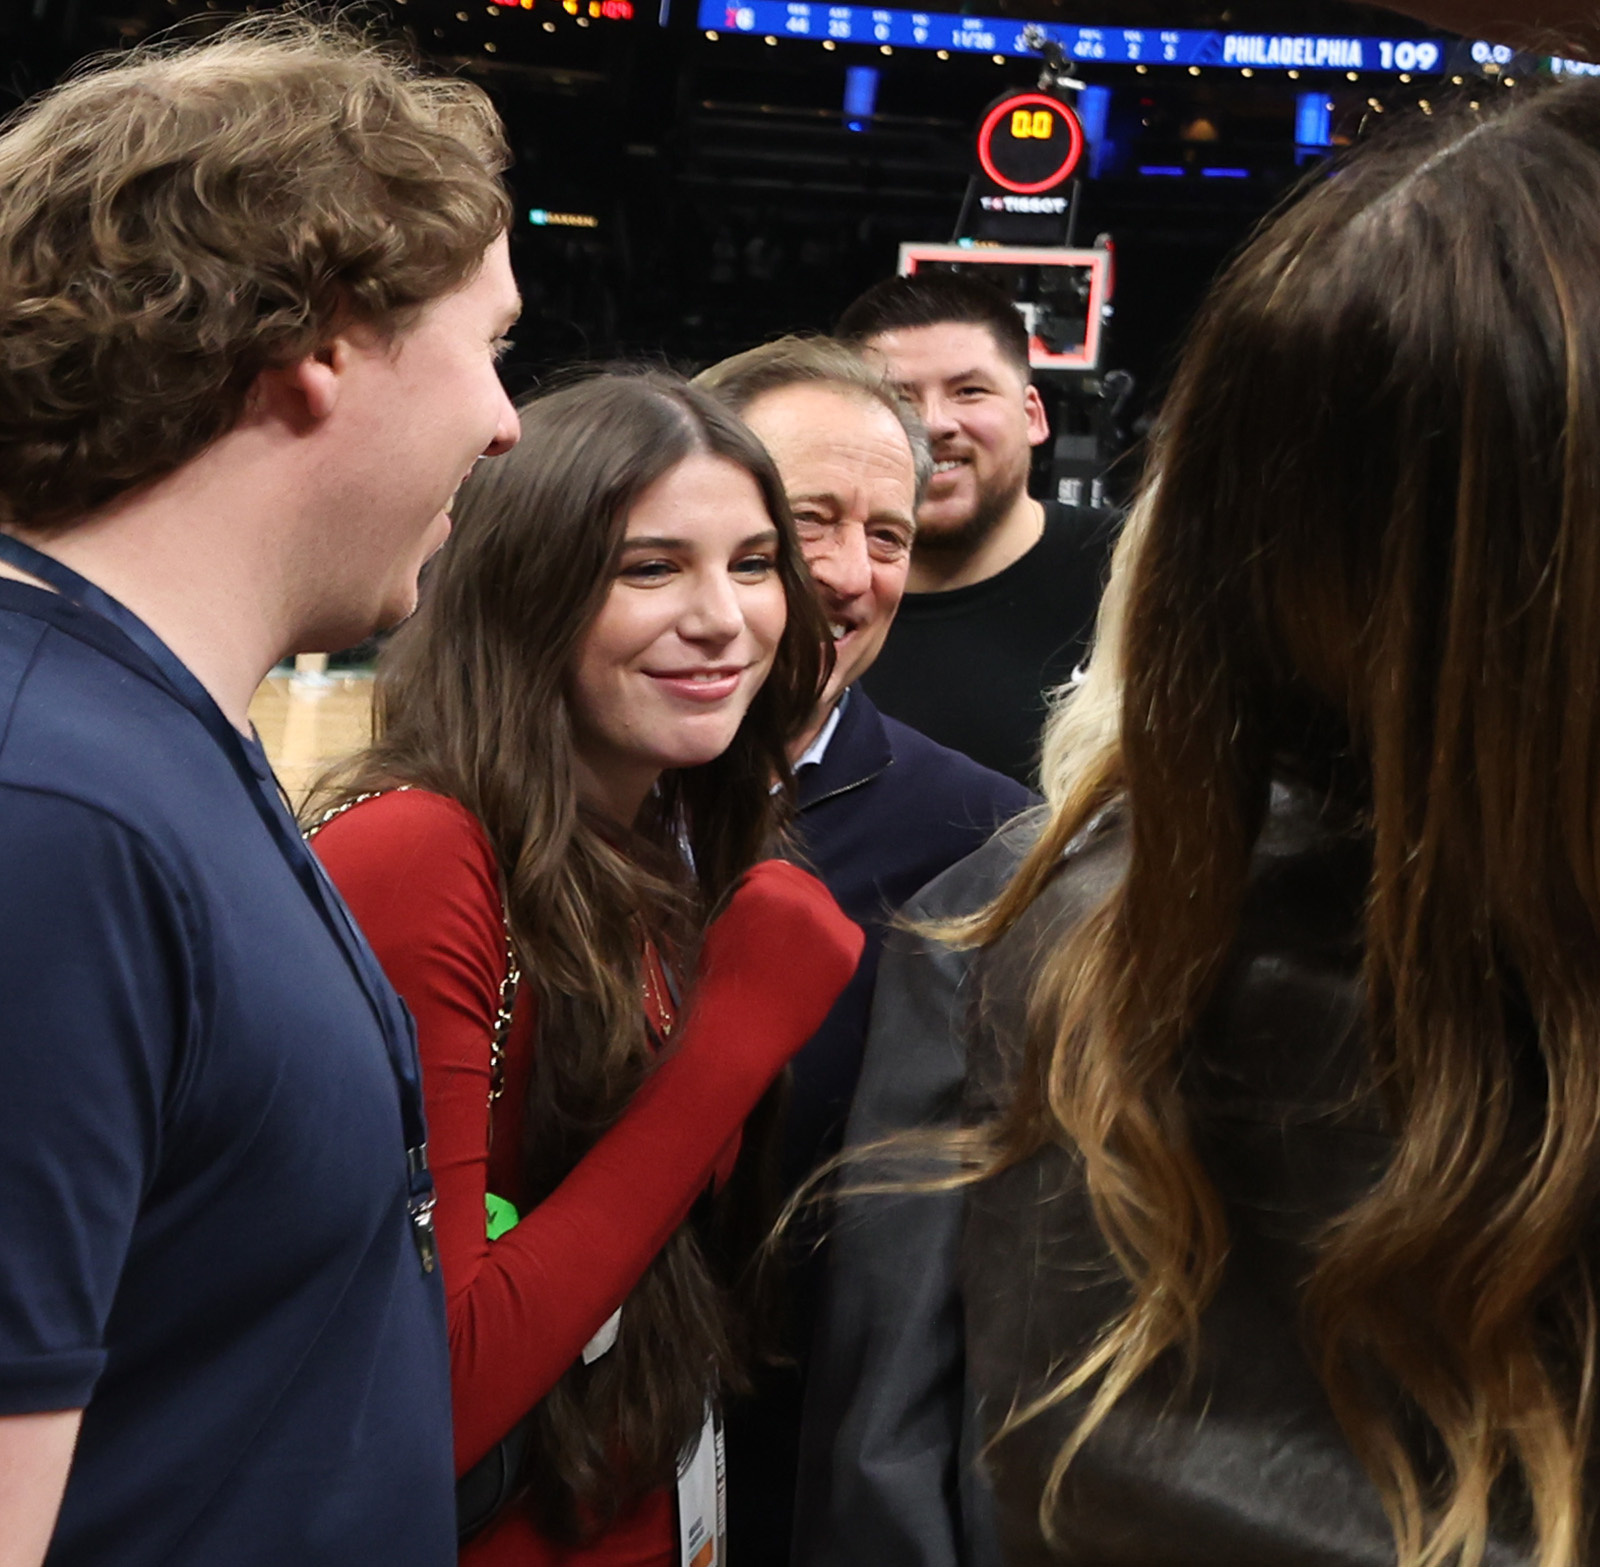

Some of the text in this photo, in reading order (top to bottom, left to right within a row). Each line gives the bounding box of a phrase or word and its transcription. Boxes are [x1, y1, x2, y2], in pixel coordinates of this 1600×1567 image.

[1223, 34, 1439, 71] PHILADELPHIA 109
[1471, 40, 1512, 65] 0.0
